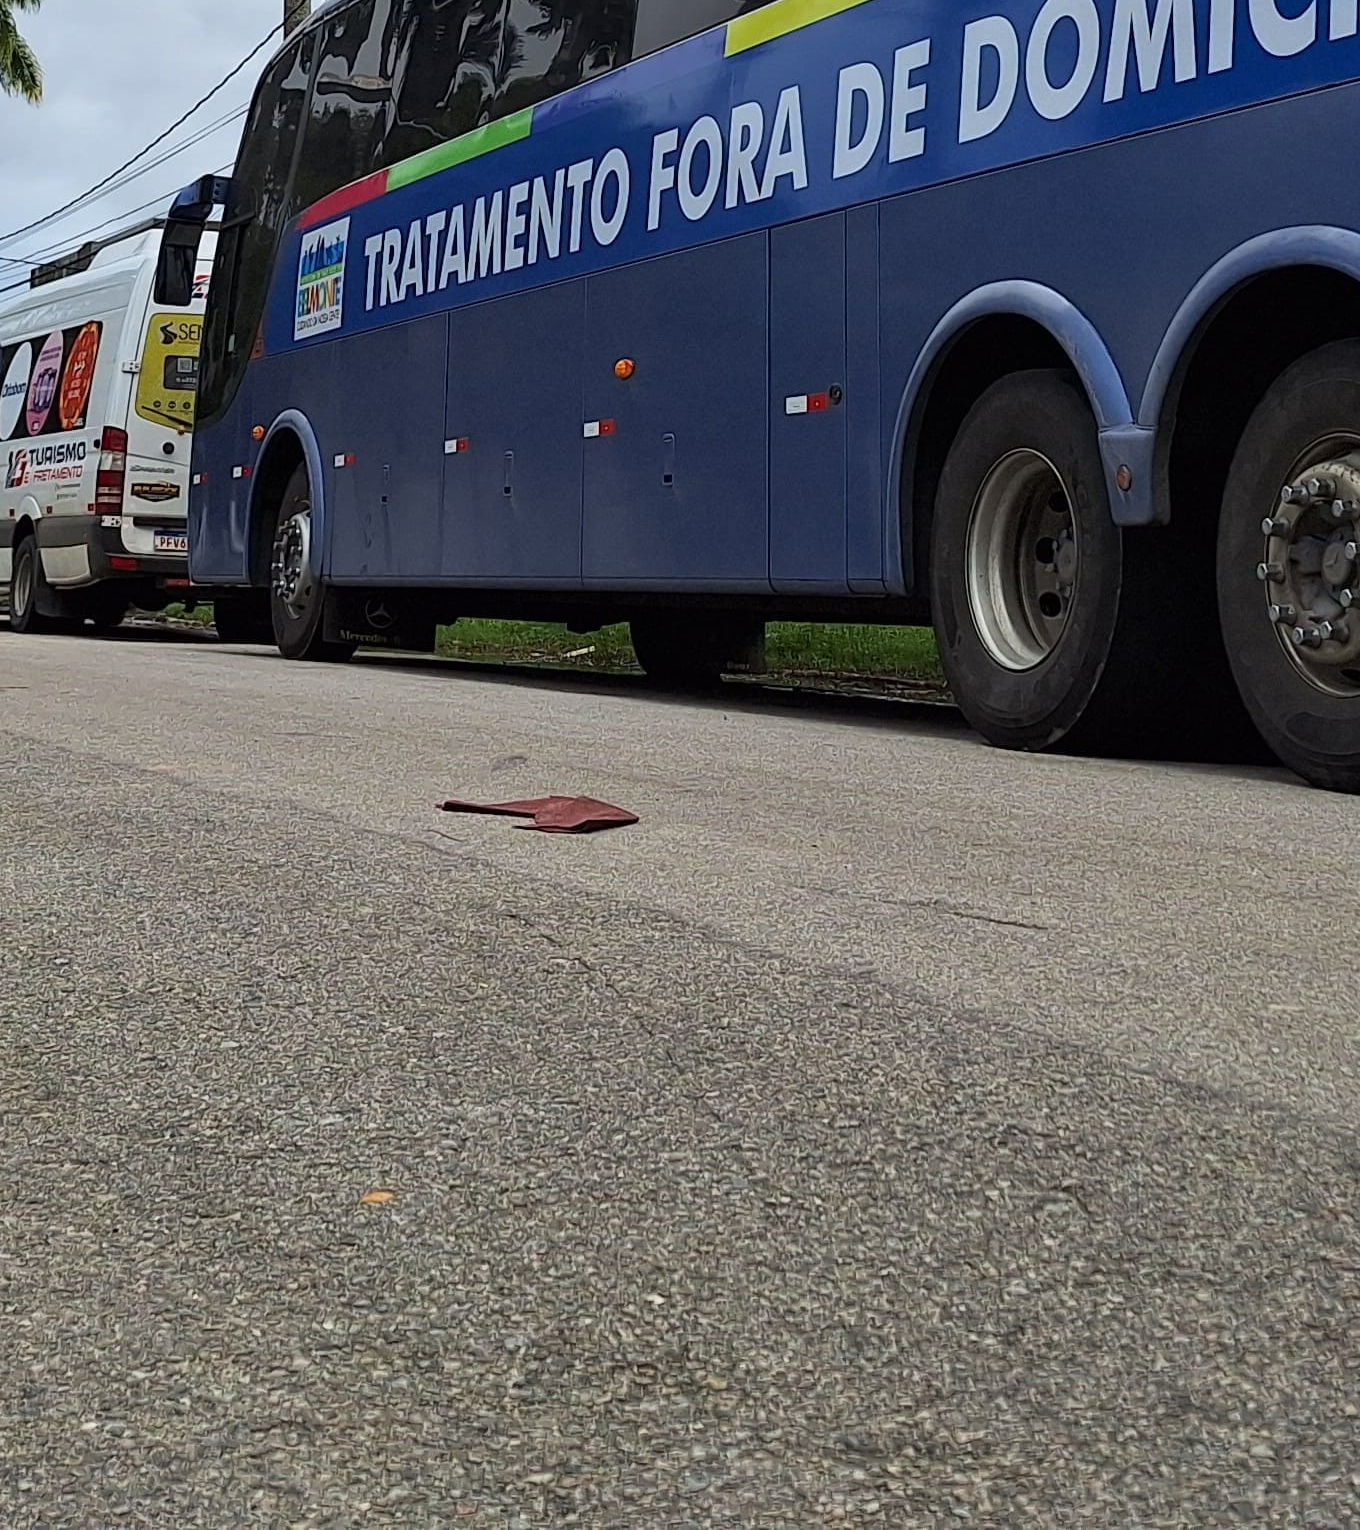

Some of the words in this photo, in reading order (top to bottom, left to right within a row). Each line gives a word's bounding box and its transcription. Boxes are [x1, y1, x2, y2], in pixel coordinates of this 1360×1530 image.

[364, 147, 631, 311] TRATAMENTO
[646, 84, 809, 232] FORA
[831, 38, 932, 179] DE
[28, 441, 86, 467] TURISMO
[34, 465, 83, 482] FRETAMENTO
